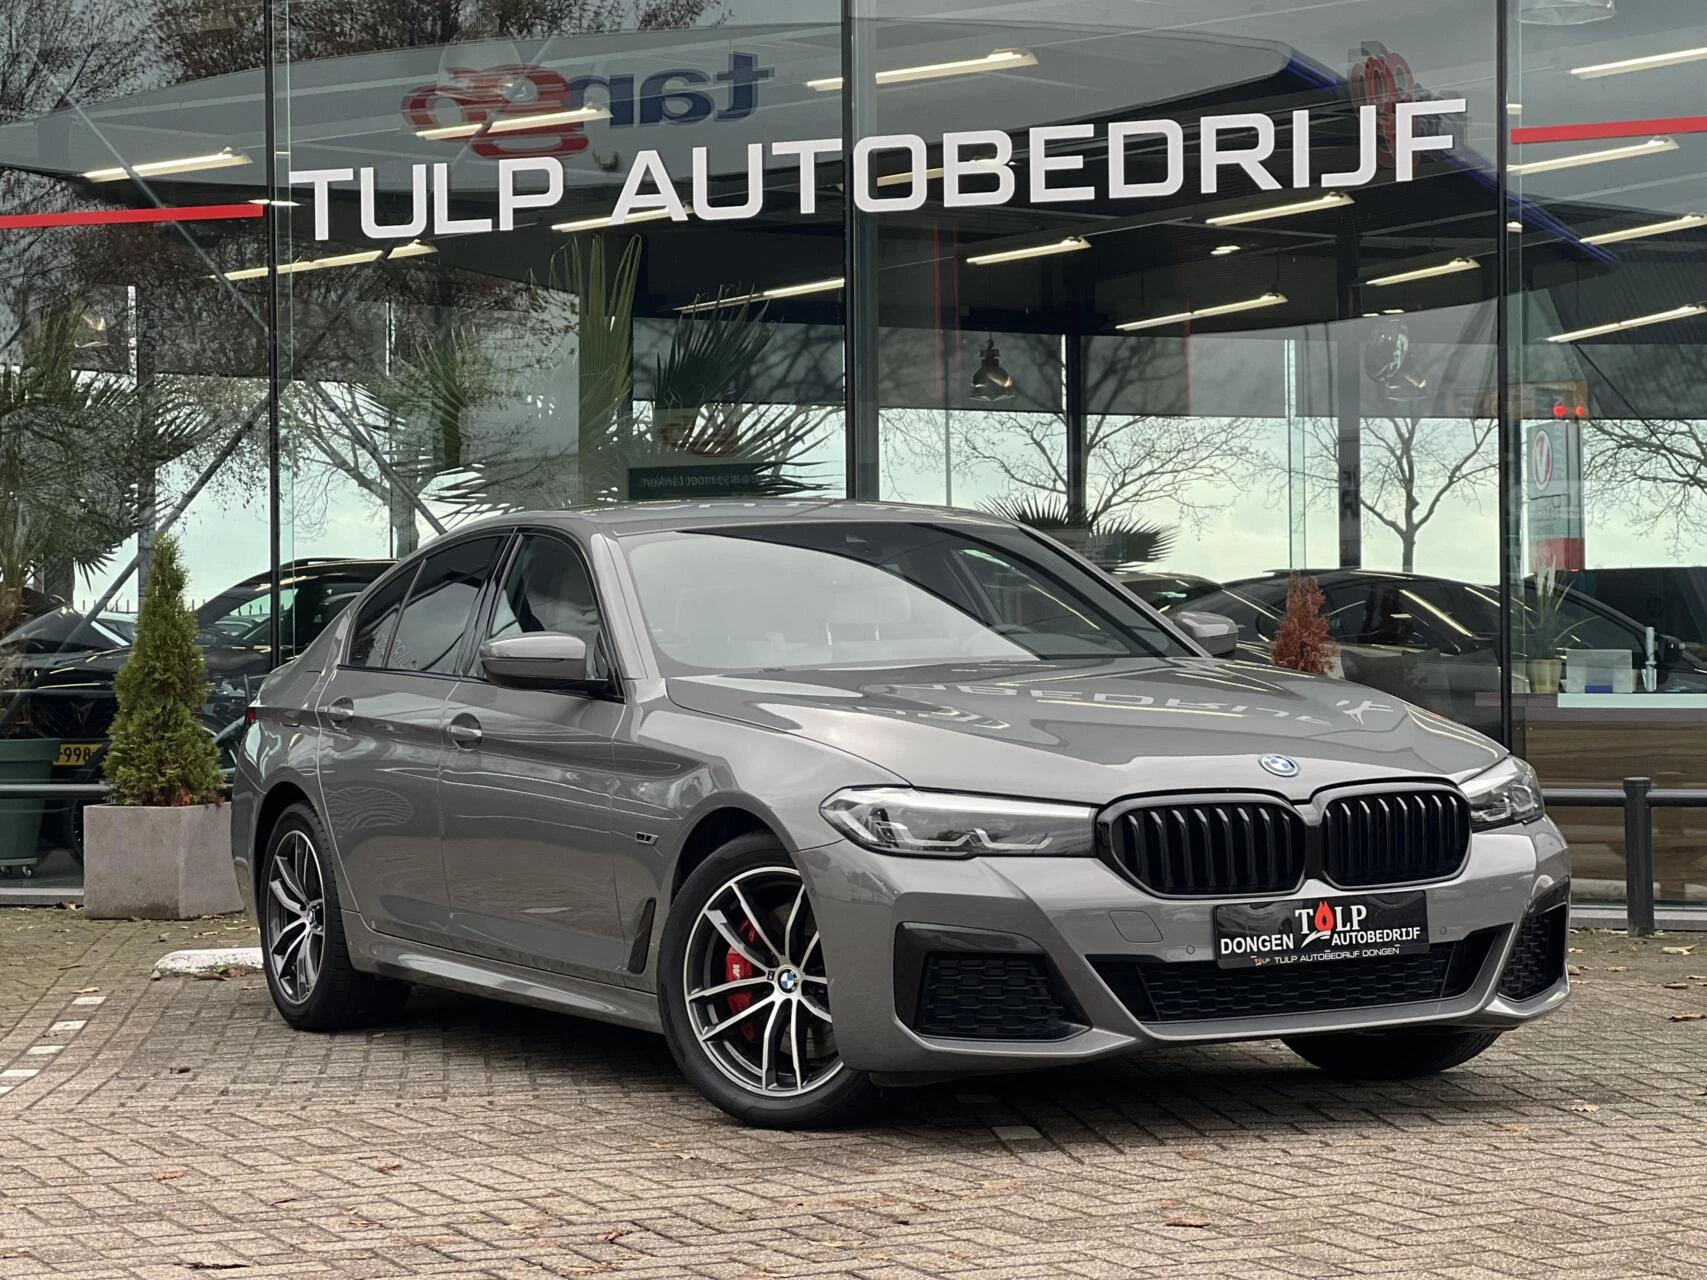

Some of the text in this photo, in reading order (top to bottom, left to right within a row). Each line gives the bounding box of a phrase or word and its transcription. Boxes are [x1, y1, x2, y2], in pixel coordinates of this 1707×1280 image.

[290, 156, 563, 241] TULP
[608, 98, 1467, 224] AUTOBEDRIJF
[1220, 933, 1294, 955] DONGEN
[1331, 926, 1421, 946] AUTOBEDRIJF
[1273, 955, 1298, 964] TULP
[1299, 950, 1361, 962] AUTOBEDRIJF
[1362, 947, 1400, 957] DONGEN
